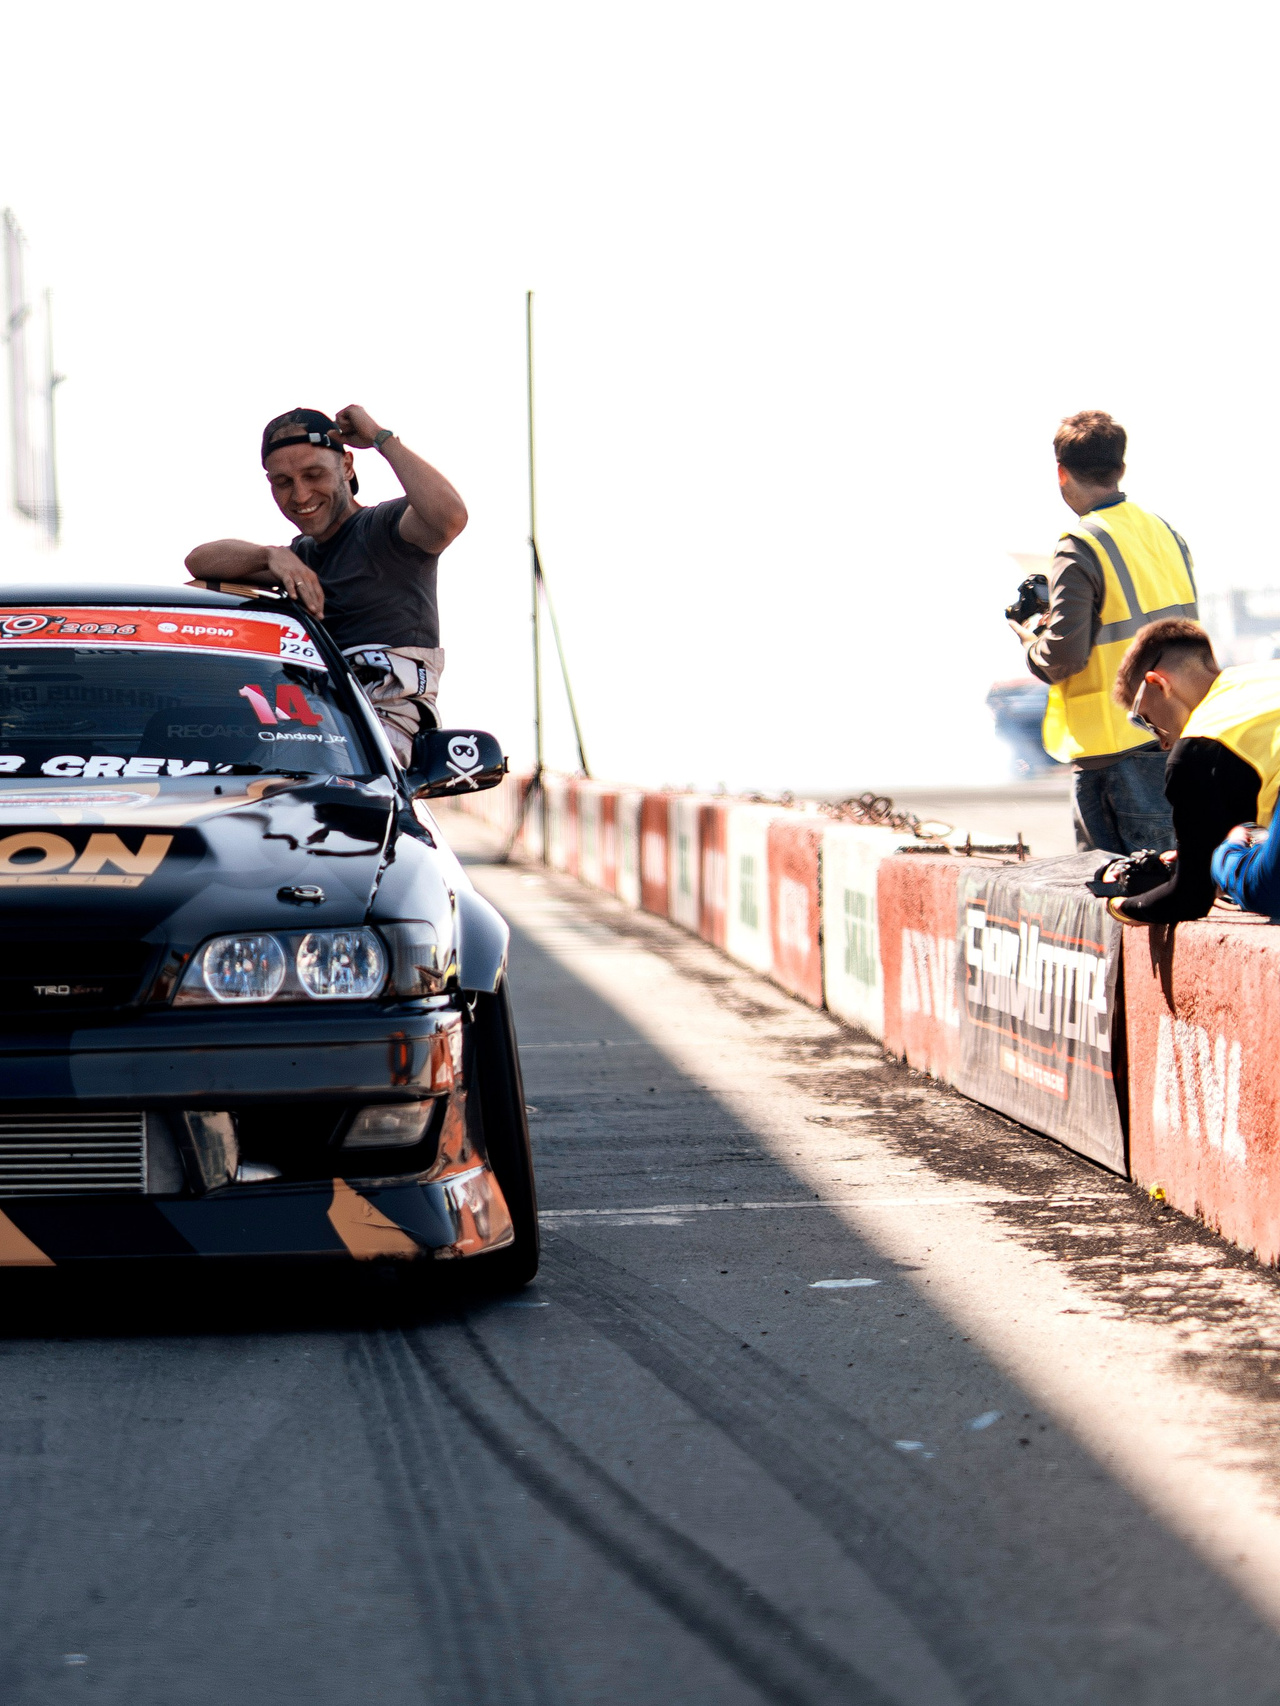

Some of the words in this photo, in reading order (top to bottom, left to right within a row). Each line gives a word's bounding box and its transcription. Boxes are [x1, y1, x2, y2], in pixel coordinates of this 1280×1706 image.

[181, 624, 234, 637] дром
[238, 683, 323, 727] 14
[33, 984, 71, 996] TRD
